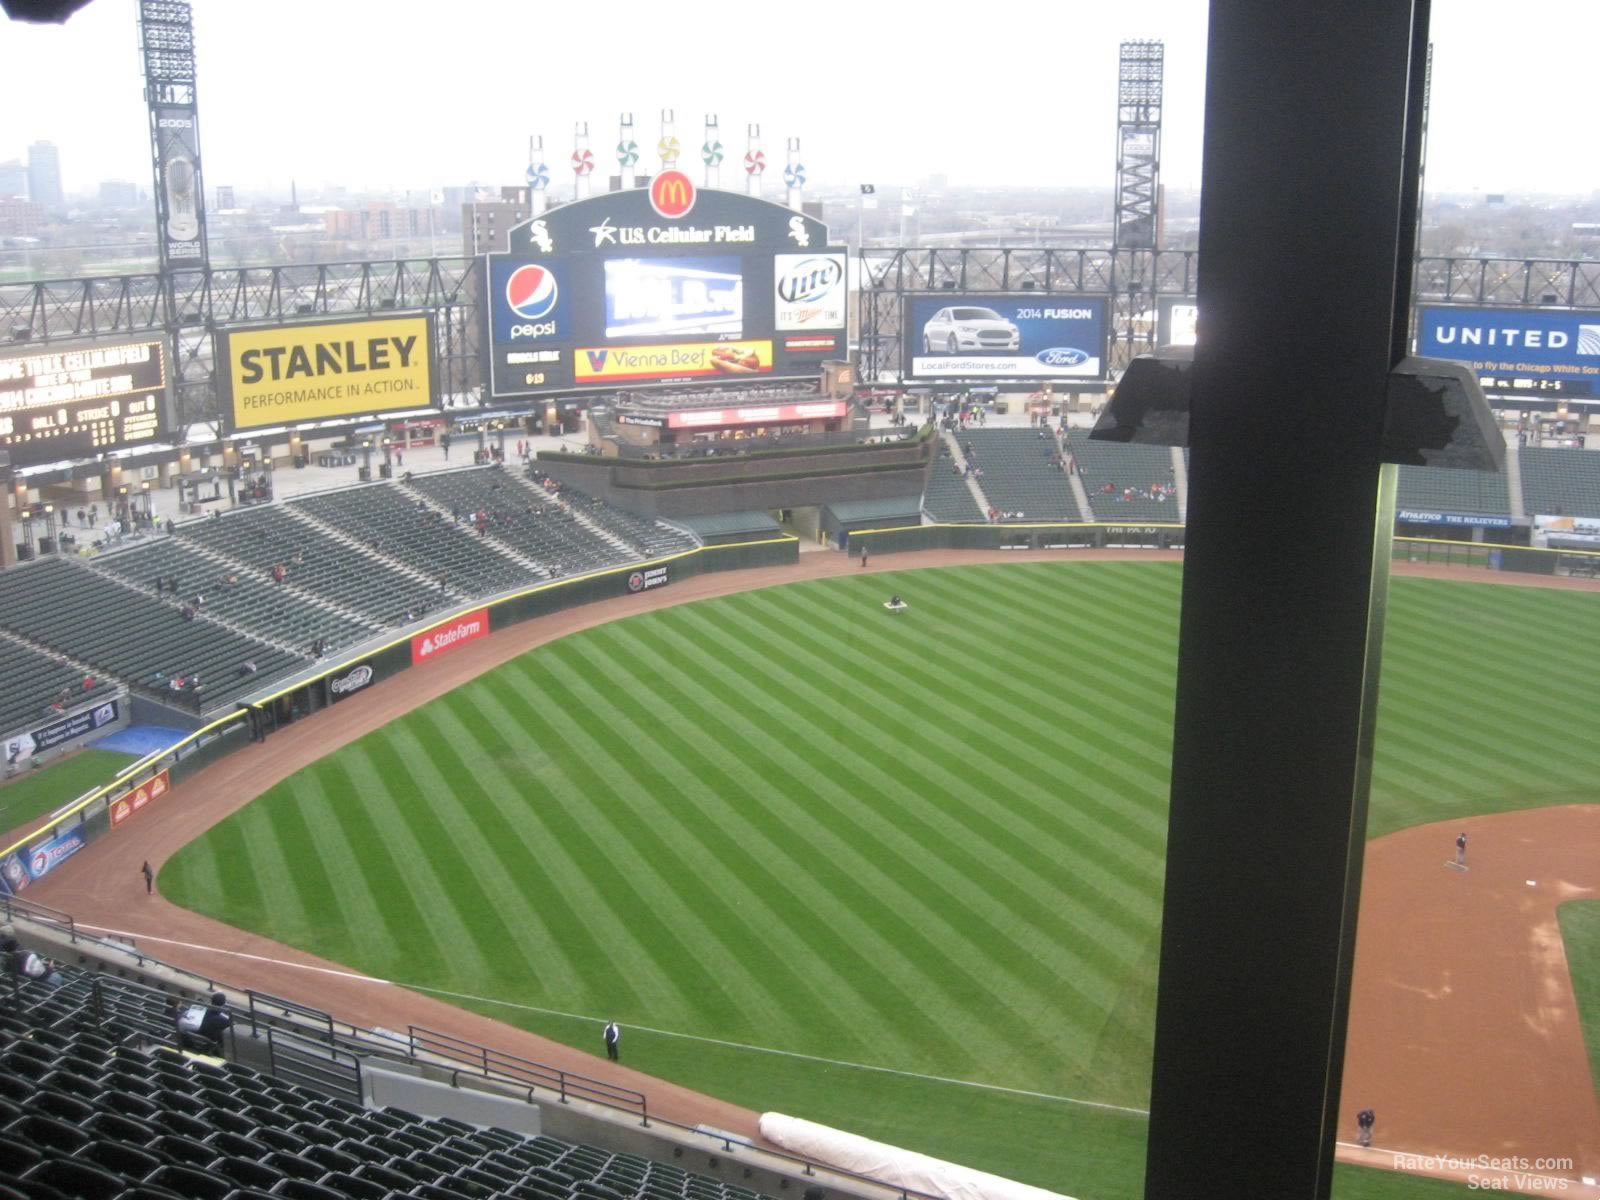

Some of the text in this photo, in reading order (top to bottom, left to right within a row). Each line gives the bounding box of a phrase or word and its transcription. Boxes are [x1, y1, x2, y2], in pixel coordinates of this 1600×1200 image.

[647, 226, 712, 244] Cellular
[714, 226, 755, 242] Field
[1016, 308, 1092, 319] 2014 FUSION
[511, 321, 555, 340] pepsi
[1436, 326, 1569, 348] UNITED
[240, 335, 417, 384] STANLEY
[613, 351, 668, 368] Vienna
[671, 348, 705, 366] Beef
[921, 361, 1017, 370] LocalFordStores.com
[1045, 349, 1079, 365] Ford
[1516, 363, 1551, 373] Chicago
[1553, 364, 1580, 374] White
[243, 385, 342, 409] PERFORMANCE
[347, 384, 360, 397] IN
